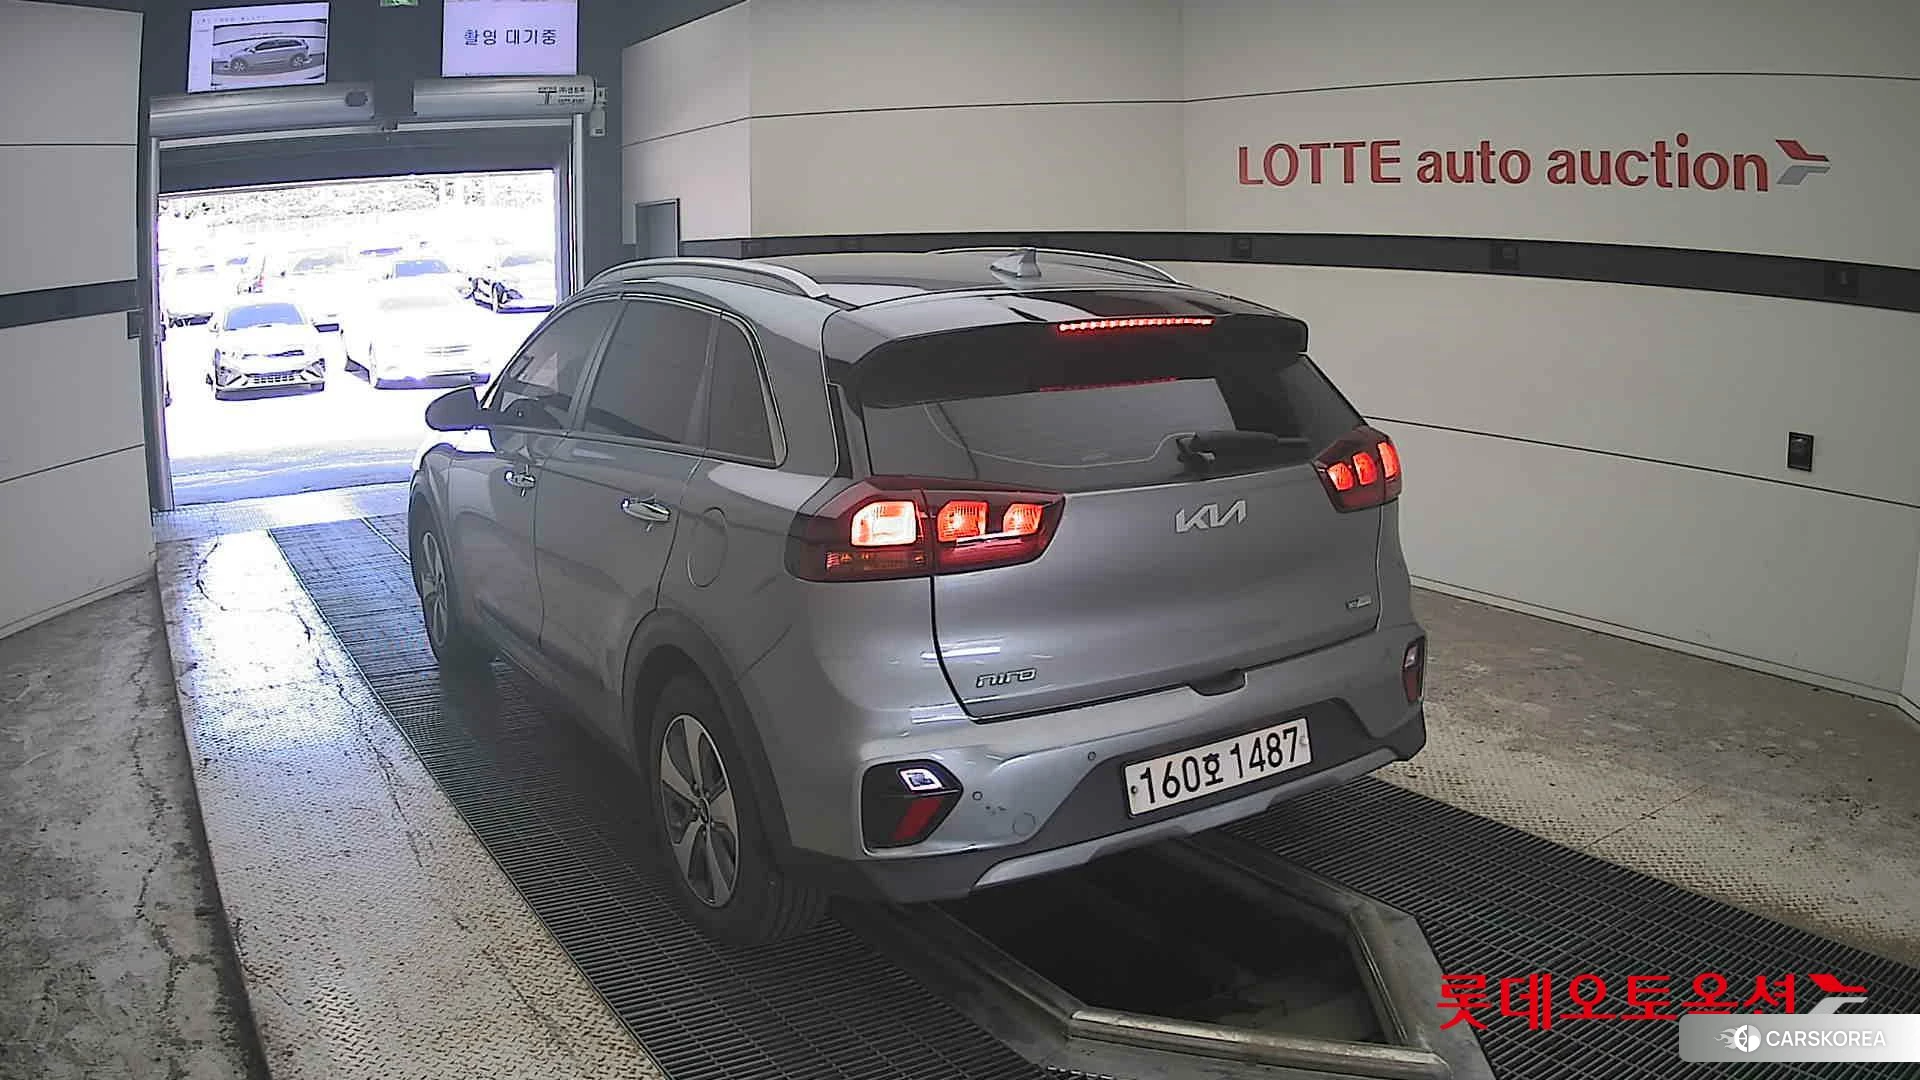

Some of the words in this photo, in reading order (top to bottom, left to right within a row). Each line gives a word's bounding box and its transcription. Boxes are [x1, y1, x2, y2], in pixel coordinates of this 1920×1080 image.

[464, 29, 498, 46] 촬영
[505, 29, 557, 46] 대기중
[1238, 140, 1401, 187] LOTTE
[1416, 140, 1532, 185] auto
[1547, 132, 1769, 192] auction
[1175, 500, 1247, 533] KIA
[1229, 726, 1298, 779] 1487
